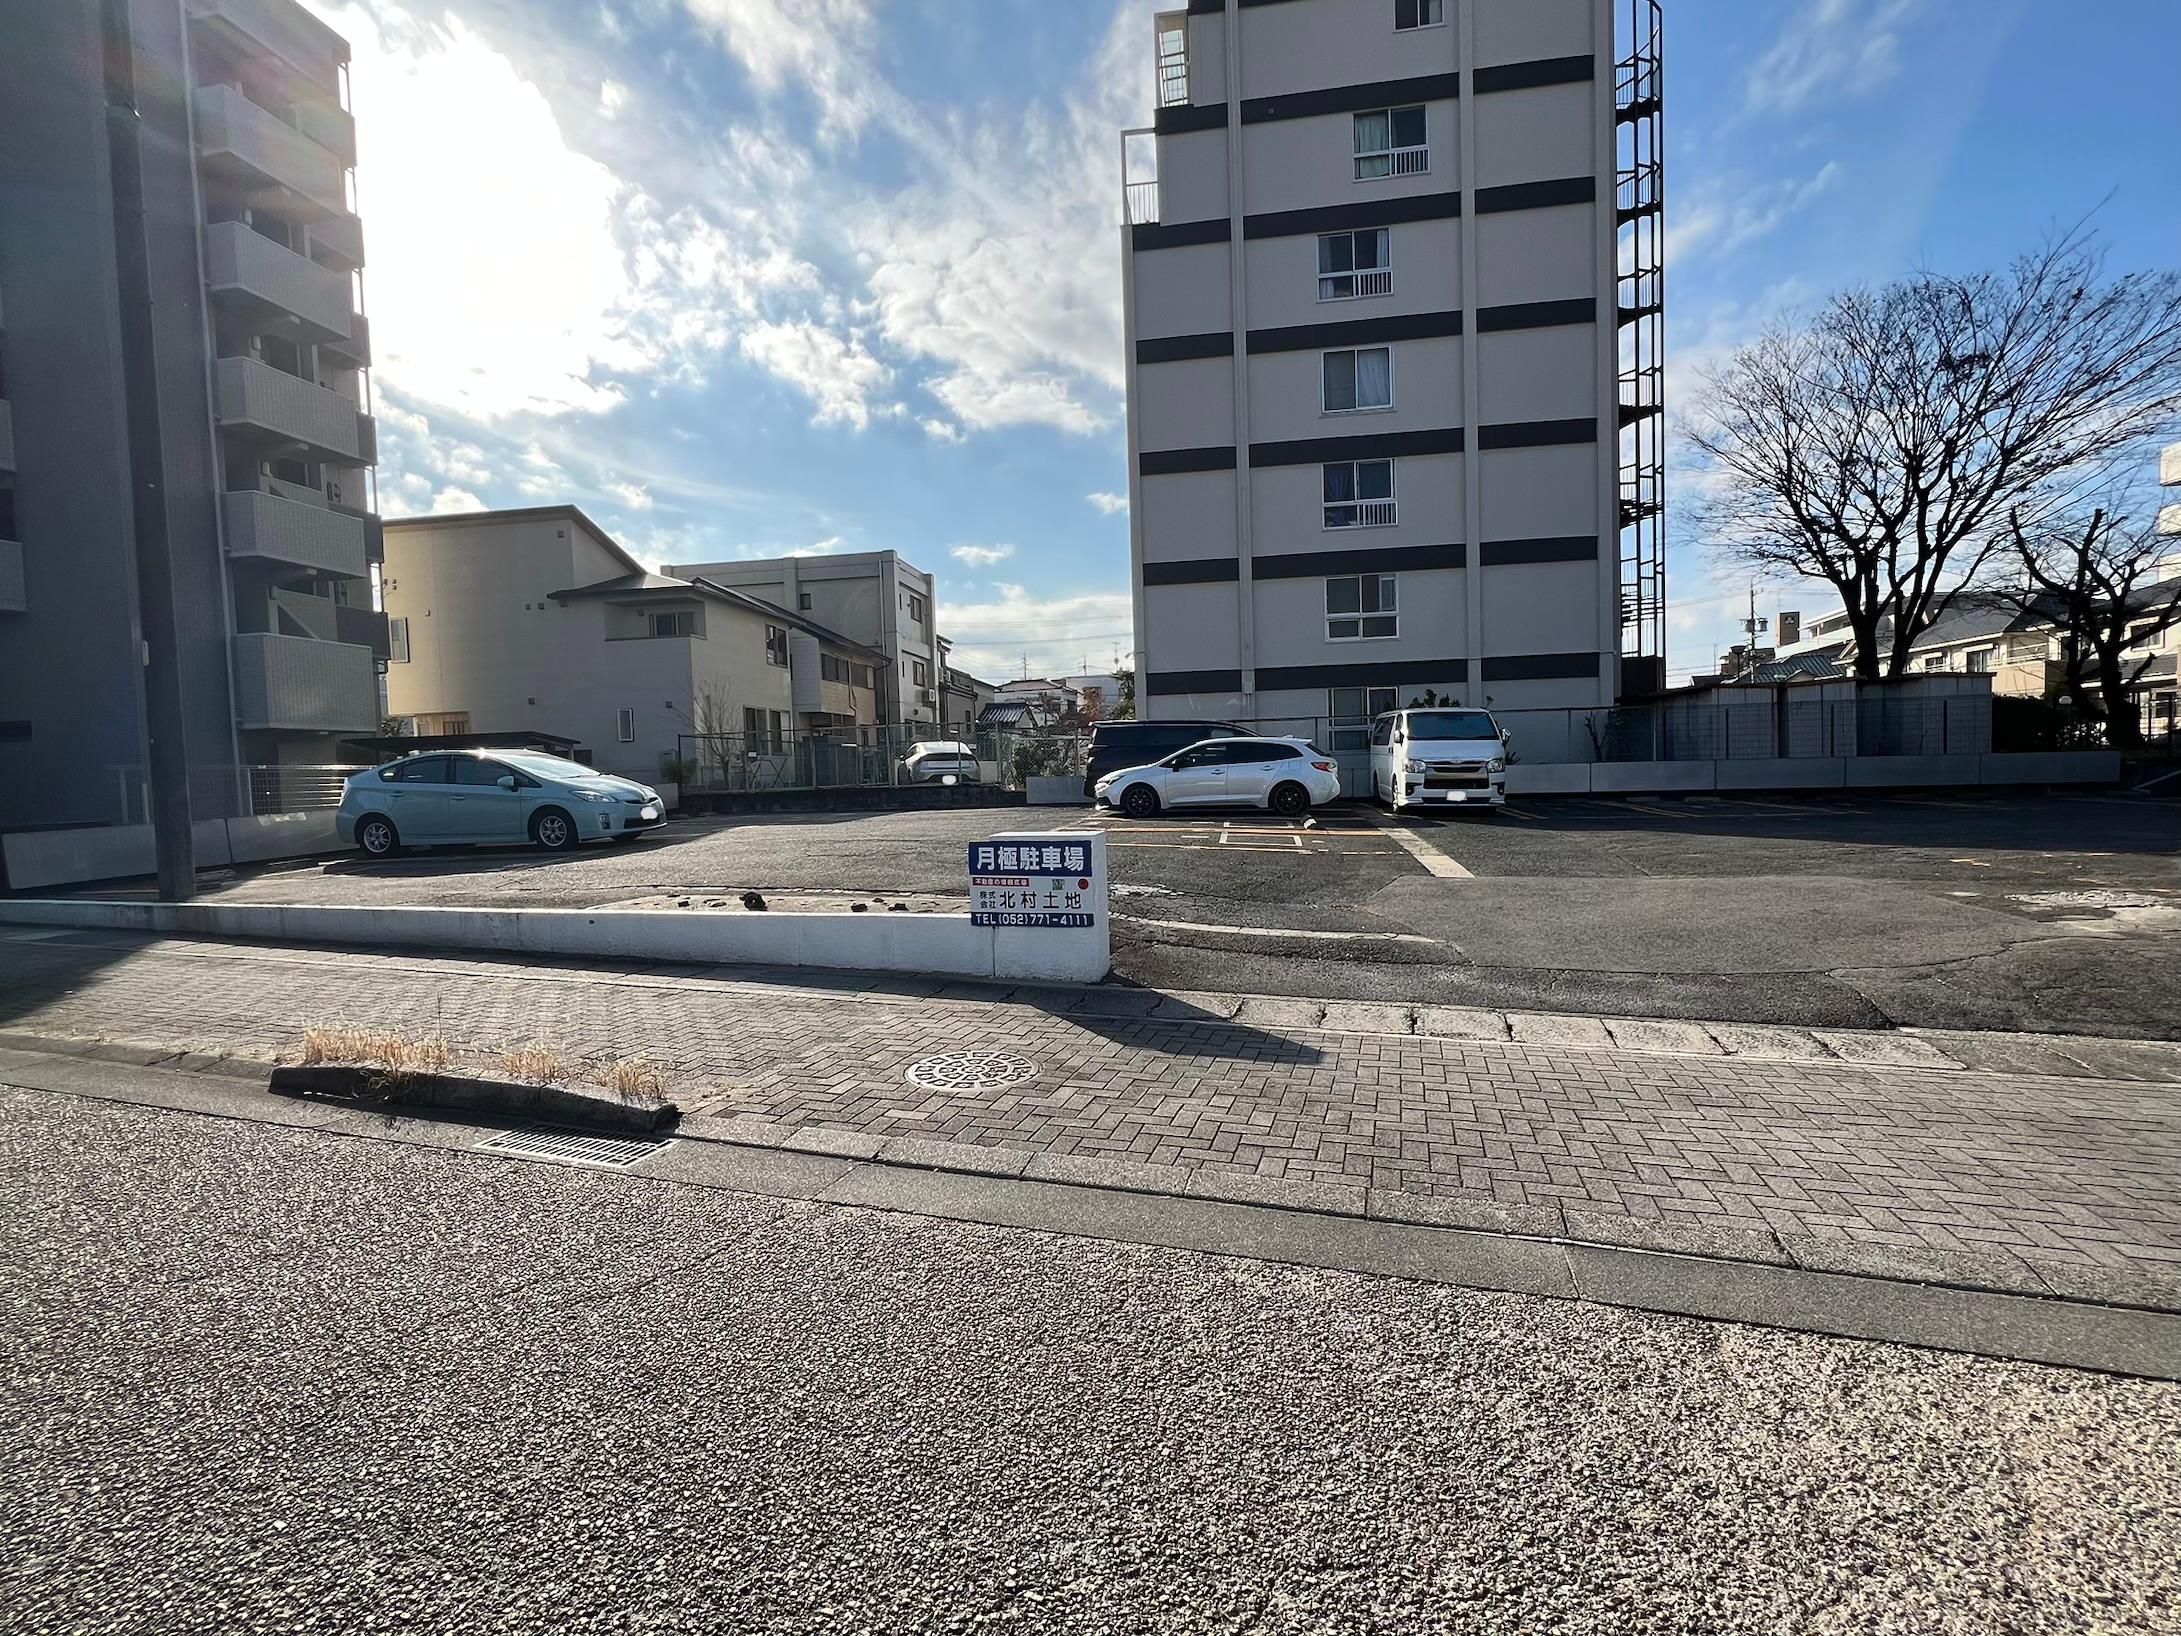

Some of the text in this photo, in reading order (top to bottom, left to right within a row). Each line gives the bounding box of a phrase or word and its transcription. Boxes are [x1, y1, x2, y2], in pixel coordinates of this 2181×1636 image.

[976, 846, 1085, 872] 月極駐車場
[979, 891, 996, 899] 株式
[999, 891, 1082, 909] 北村土地
[980, 900, 996, 909] 会社
[975, 914, 1088, 926] TEL(052)771-4111
